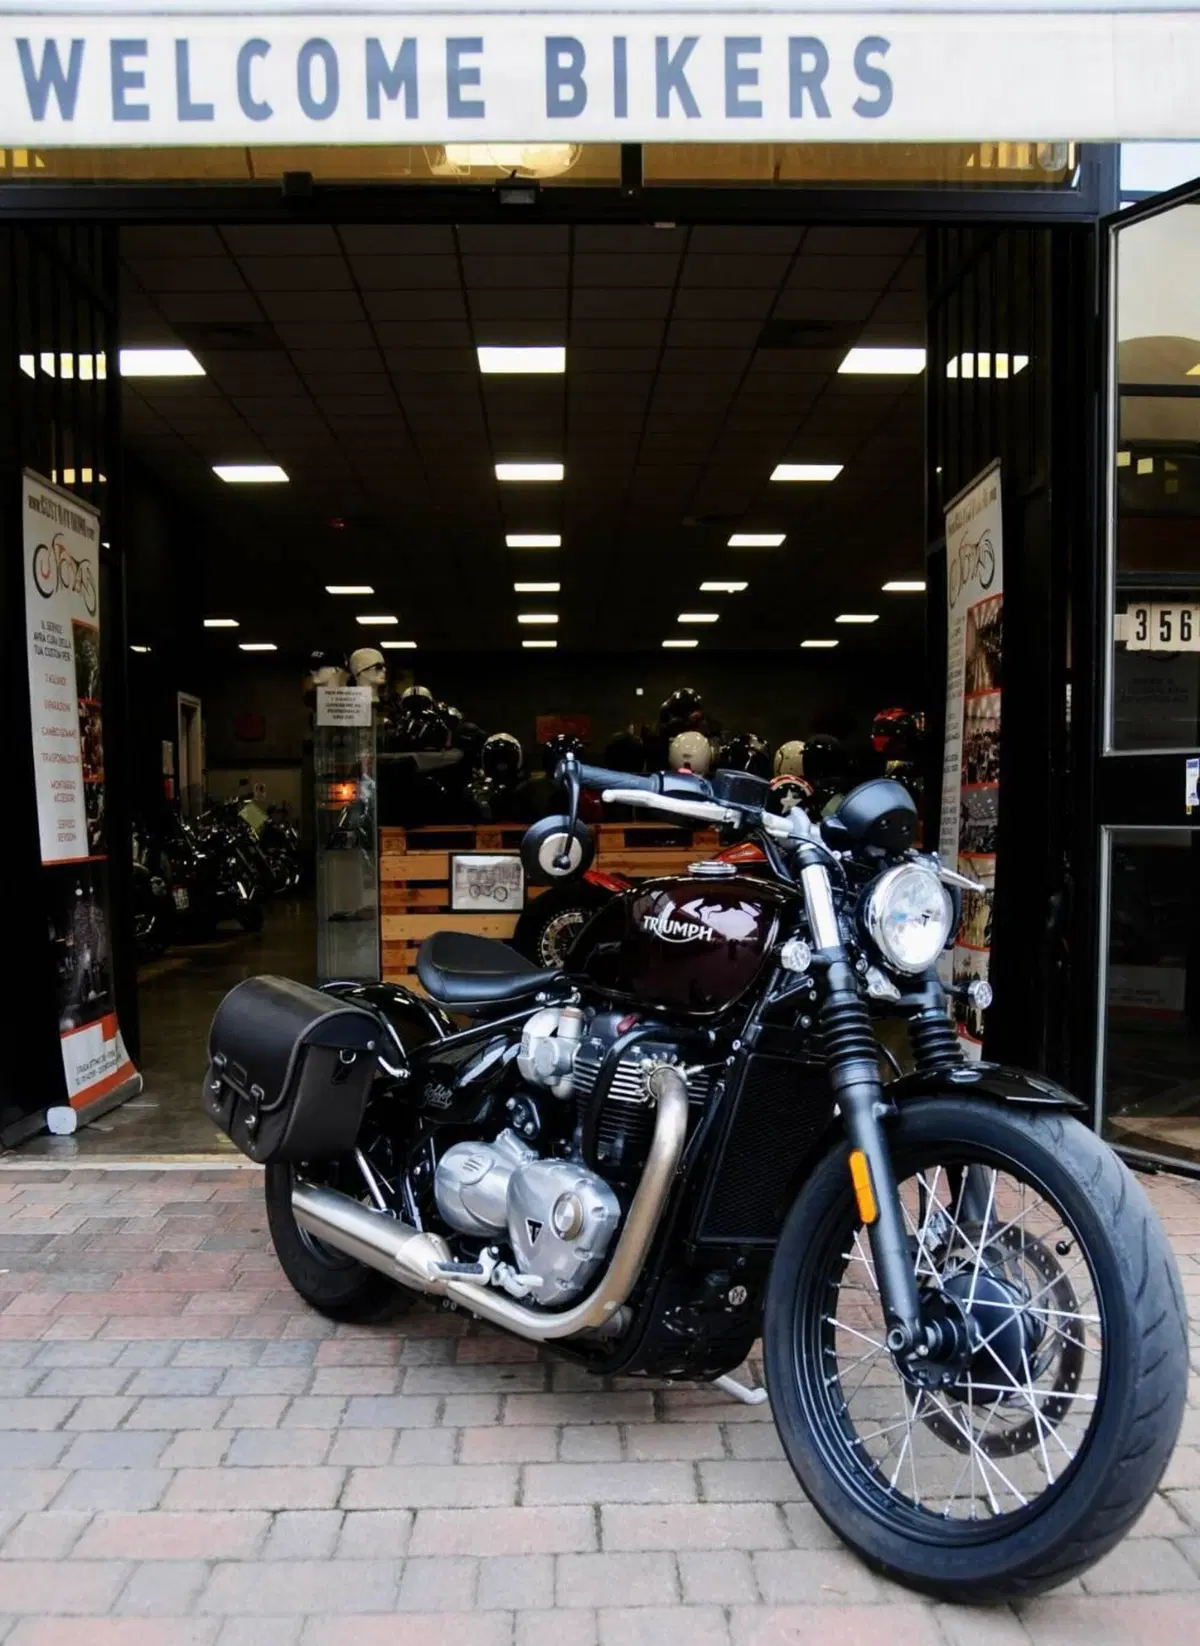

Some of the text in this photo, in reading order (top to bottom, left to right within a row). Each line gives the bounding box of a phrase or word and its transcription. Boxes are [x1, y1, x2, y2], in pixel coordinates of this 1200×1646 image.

[16, 35, 894, 122] WELCOME BIKERS
[1136, 608, 1192, 642] 356
[643, 902, 713, 942] TRIUMPH
